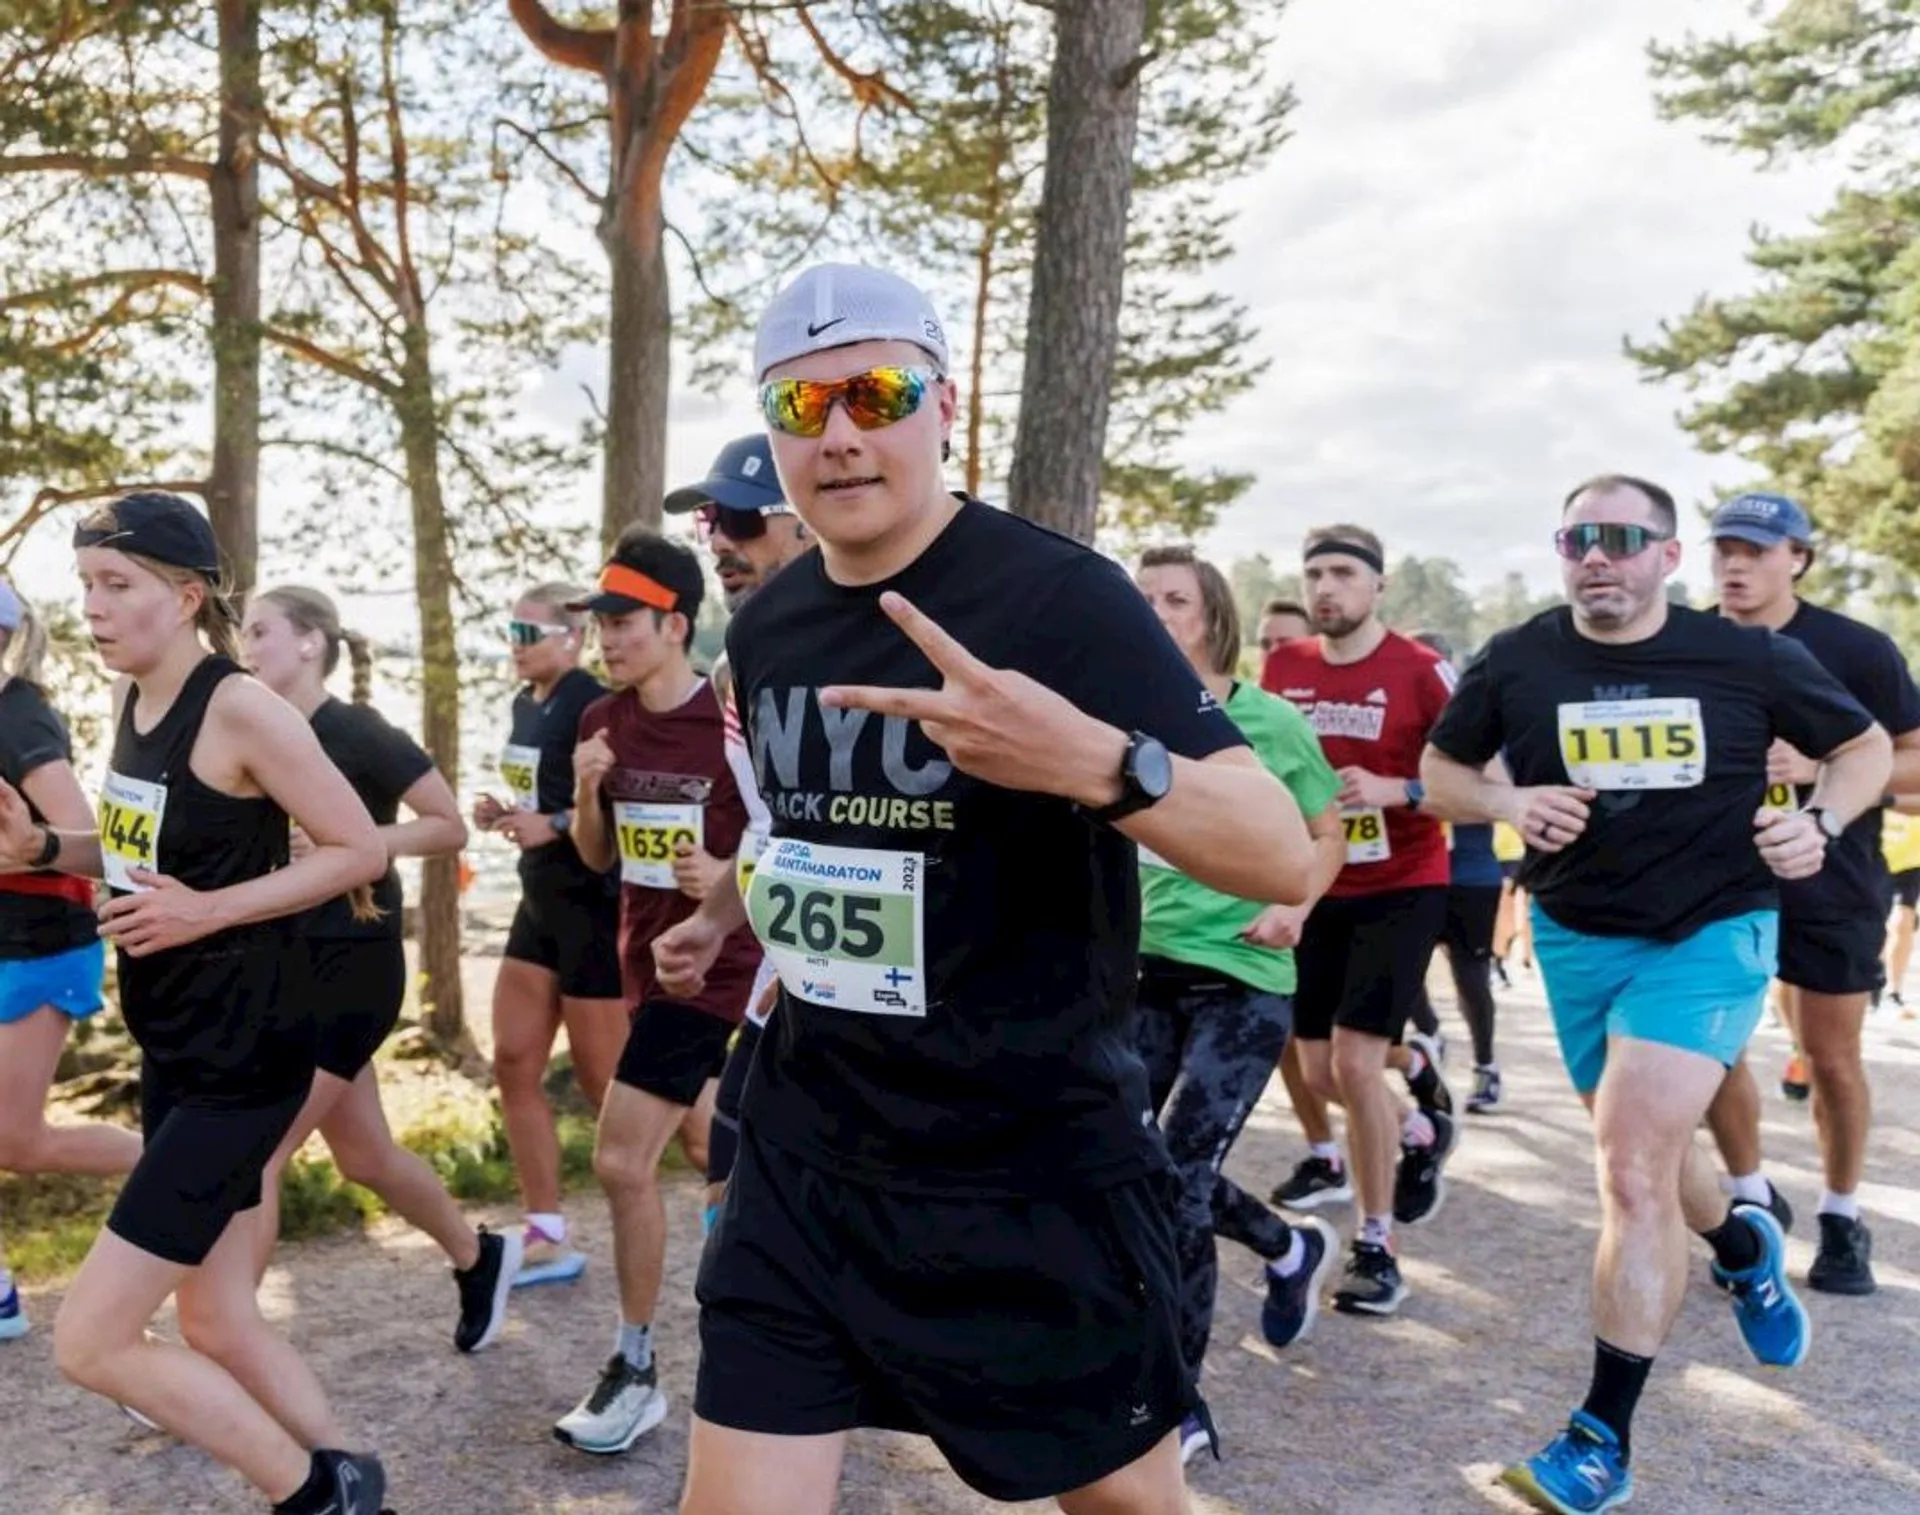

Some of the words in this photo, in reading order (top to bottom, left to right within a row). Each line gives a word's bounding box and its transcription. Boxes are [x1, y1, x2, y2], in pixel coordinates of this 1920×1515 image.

[753, 686, 951, 796] NYC
[1569, 724, 1696, 761] 1115
[829, 795, 955, 830] COURSE
[768, 883, 885, 958] 265
